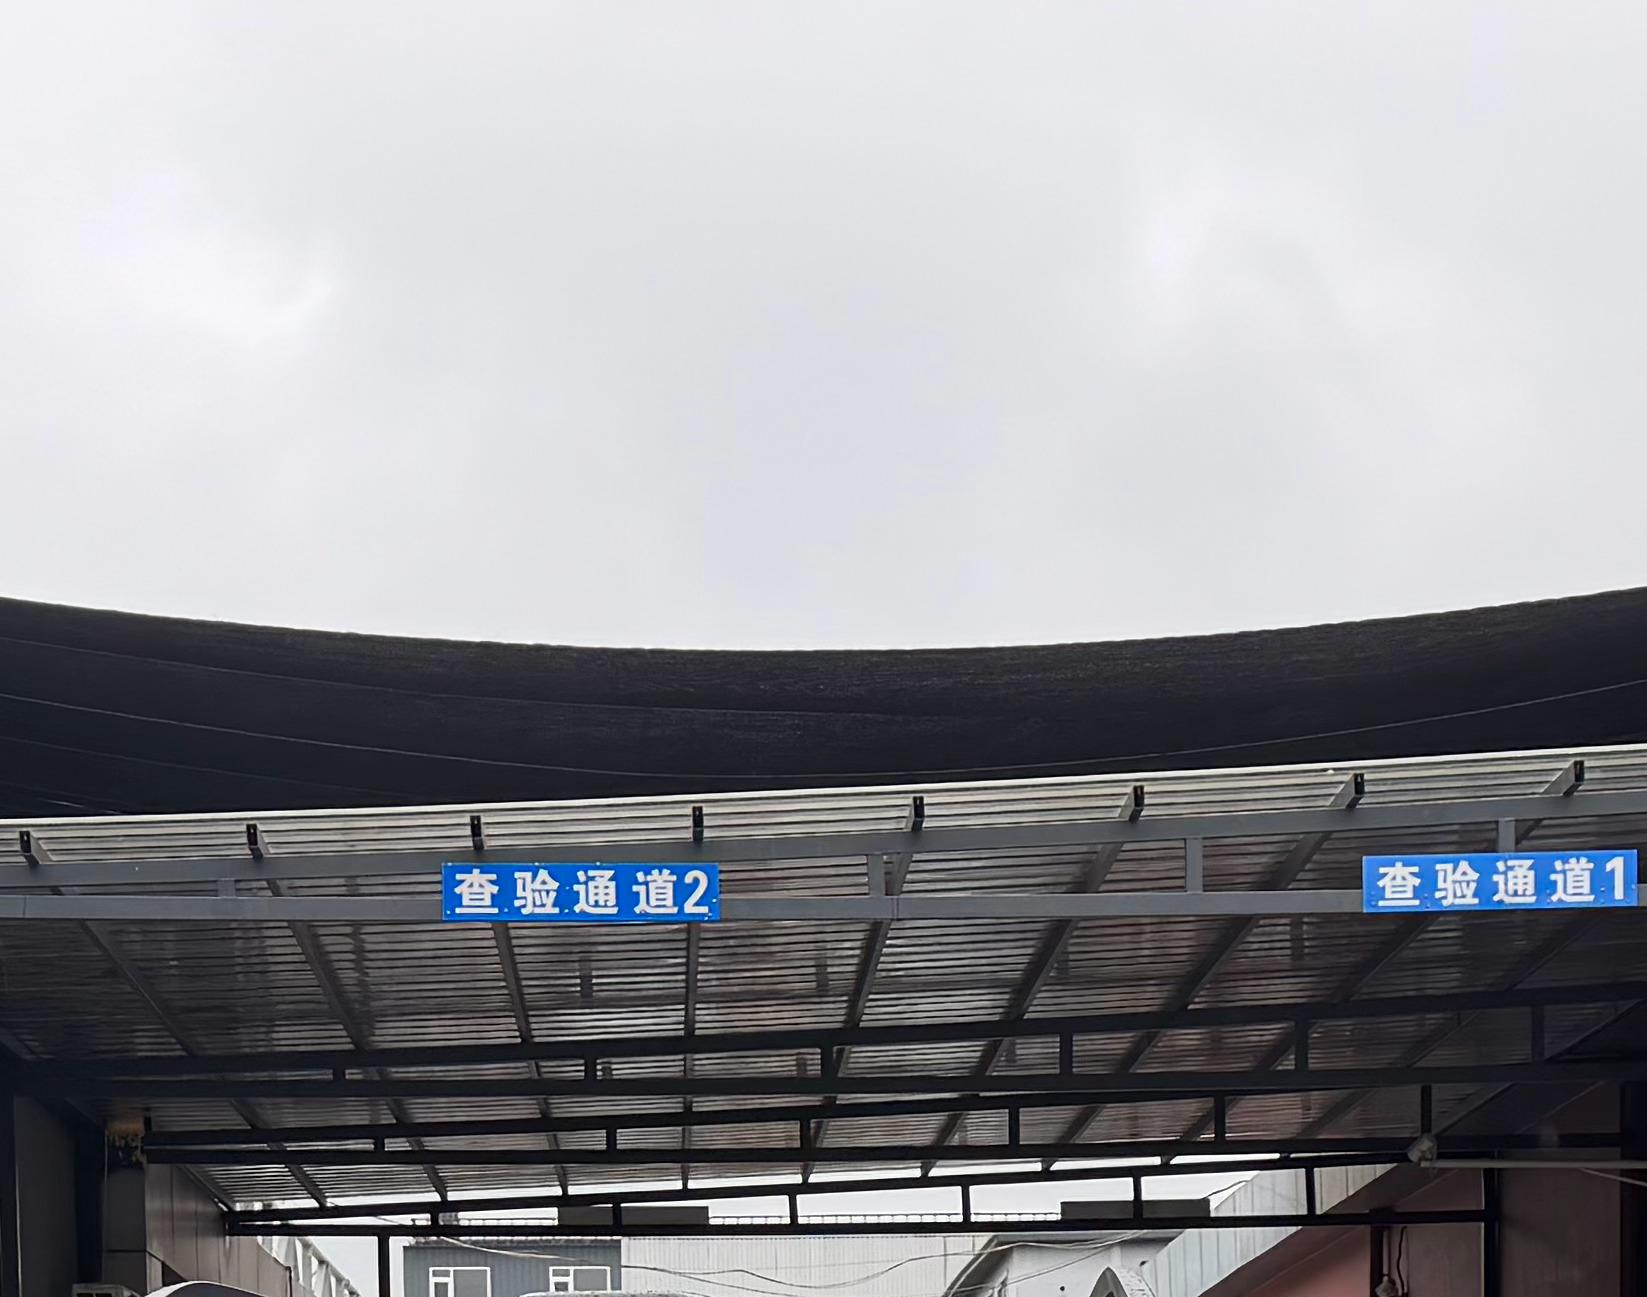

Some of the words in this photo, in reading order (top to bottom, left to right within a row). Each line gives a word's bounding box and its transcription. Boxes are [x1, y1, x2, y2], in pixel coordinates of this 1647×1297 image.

[454, 868, 709, 915] 查验通道2
[1377, 856, 1625, 907] 查验通道1
